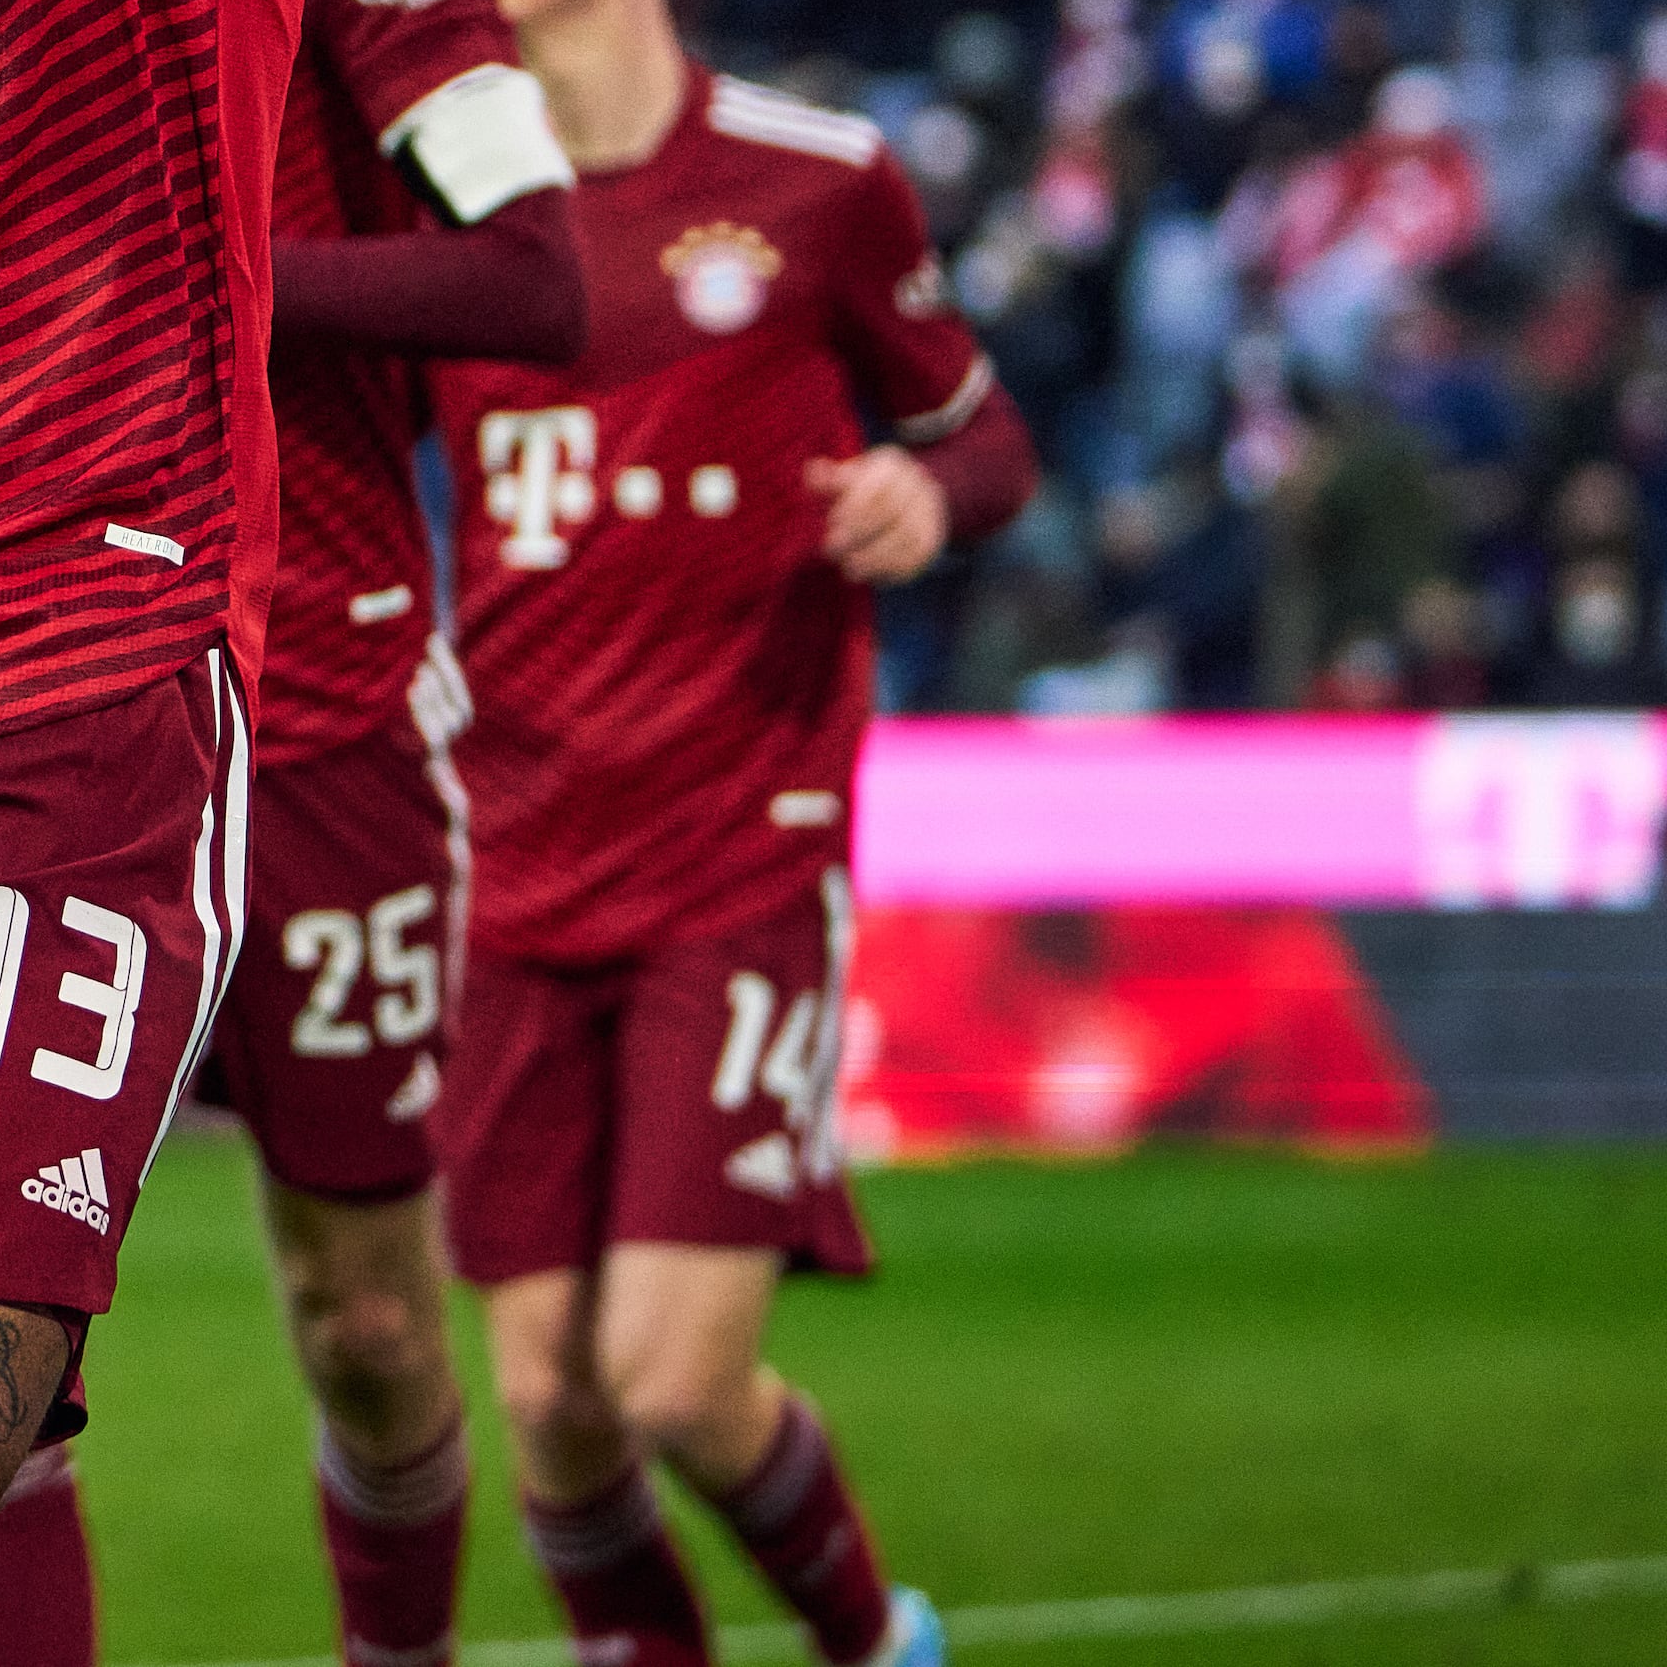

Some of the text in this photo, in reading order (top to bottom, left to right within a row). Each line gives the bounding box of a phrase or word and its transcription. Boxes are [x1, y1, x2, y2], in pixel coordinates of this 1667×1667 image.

[283, 884, 440, 1058] 25
[711, 970, 823, 1131] 14
[20, 1178, 110, 1236] adidas
